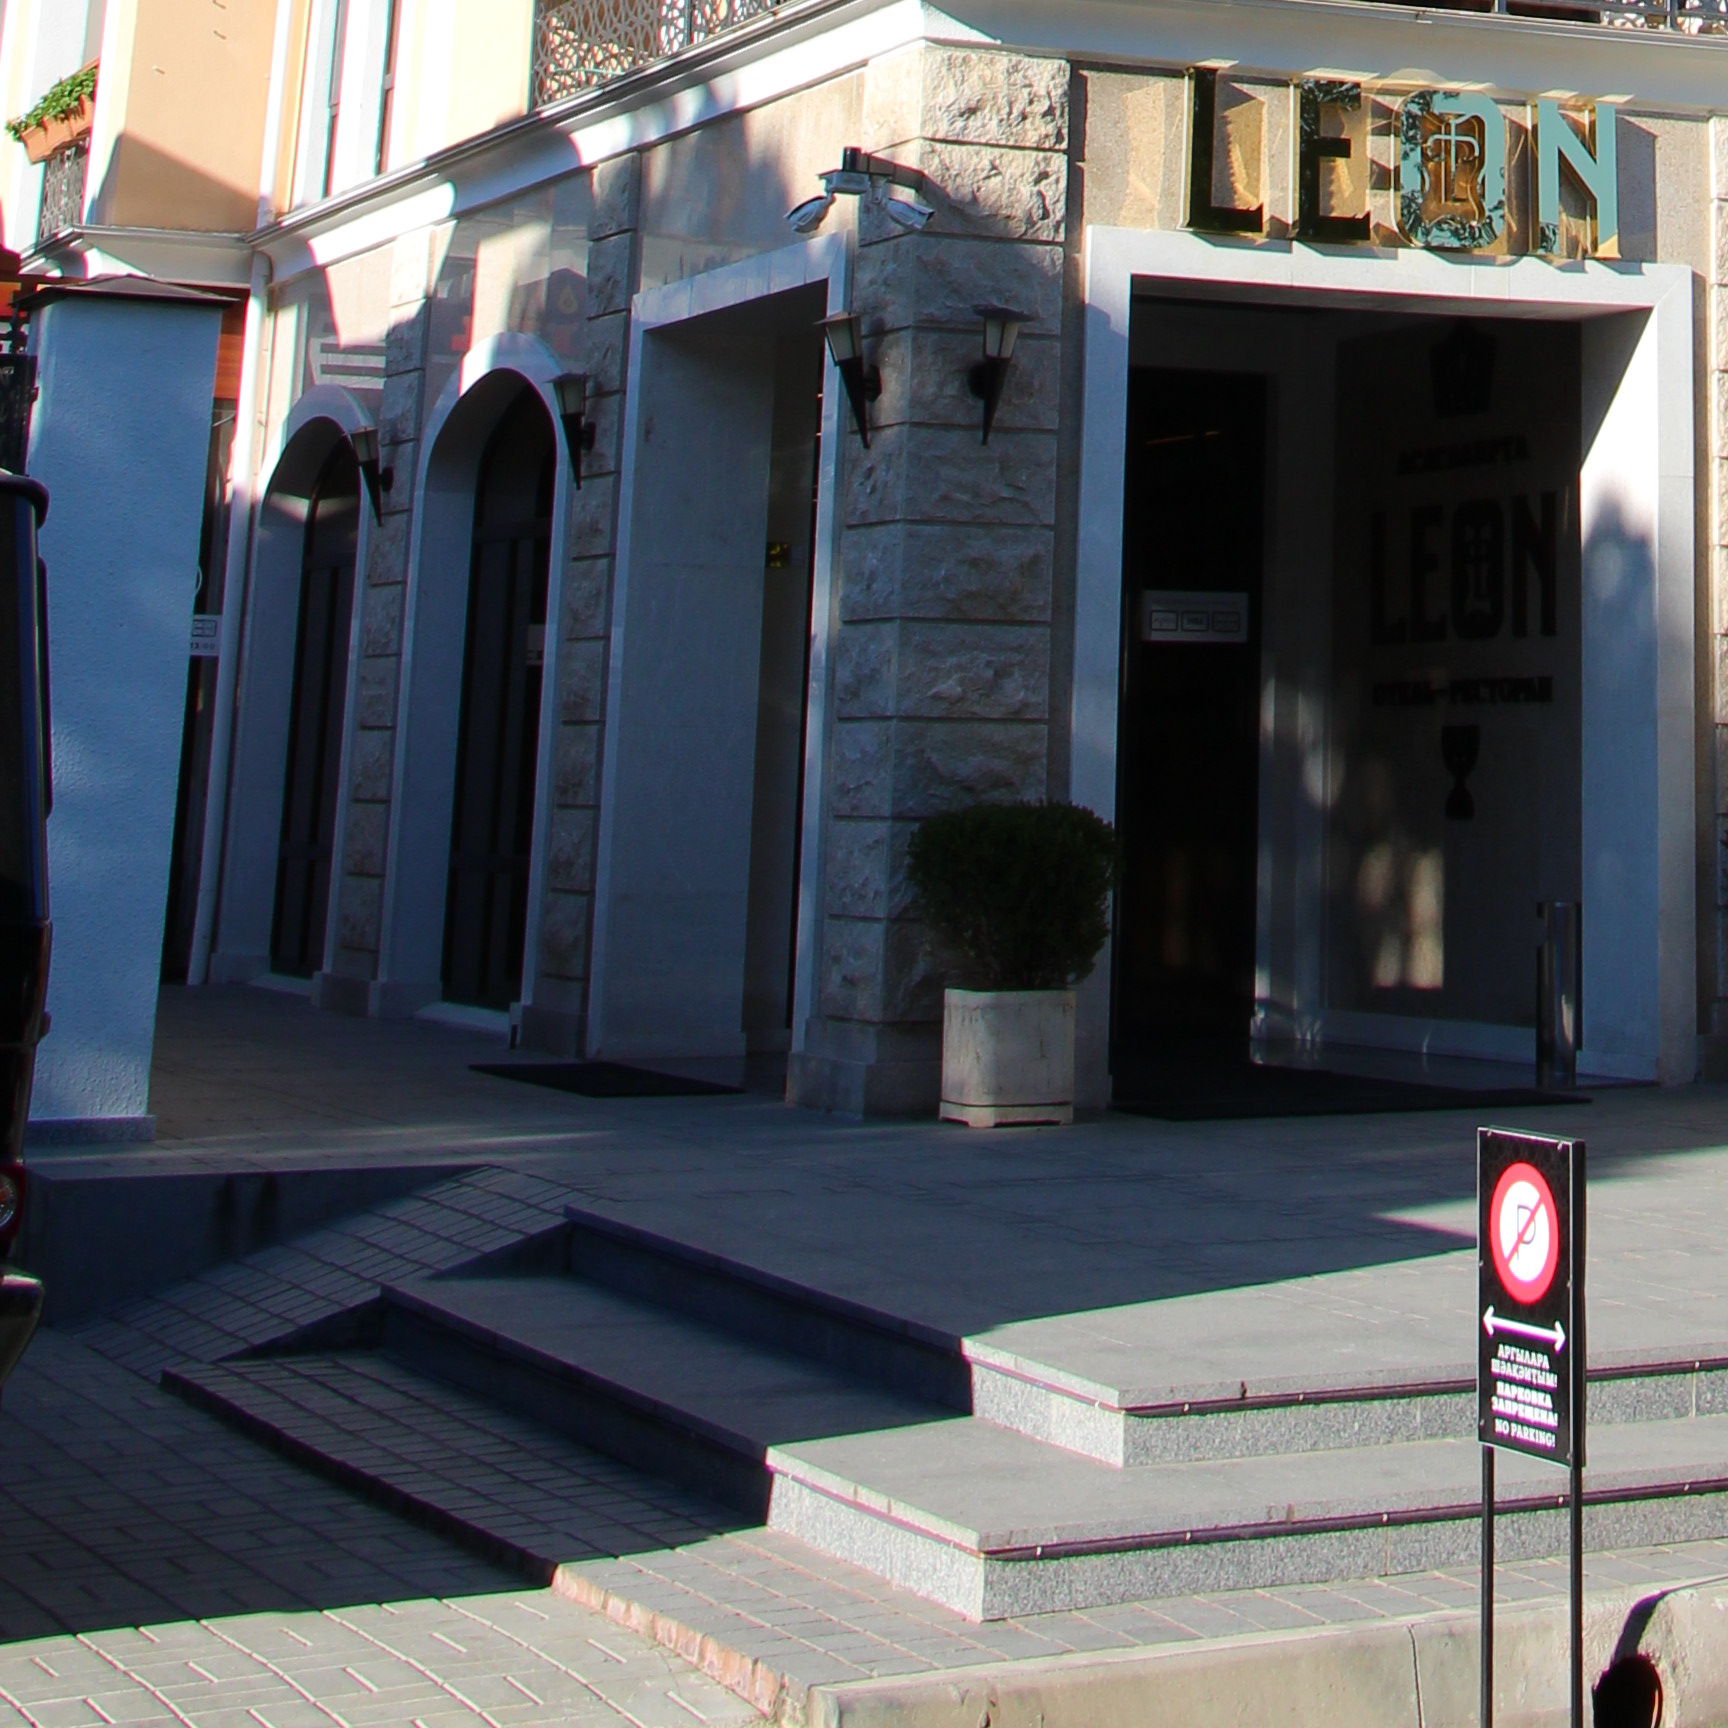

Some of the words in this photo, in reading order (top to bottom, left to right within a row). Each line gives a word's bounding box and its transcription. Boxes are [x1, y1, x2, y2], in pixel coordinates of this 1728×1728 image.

[1184, 66, 1622, 259] LEON
[1496, 1380, 1553, 1410] ПАРКОВКА
[1491, 1395, 1559, 1427] ЗАПРЕЩЕНА!
[1494, 1417, 1510, 1435] NO
[1510, 1422, 1556, 1448] PARKING!
